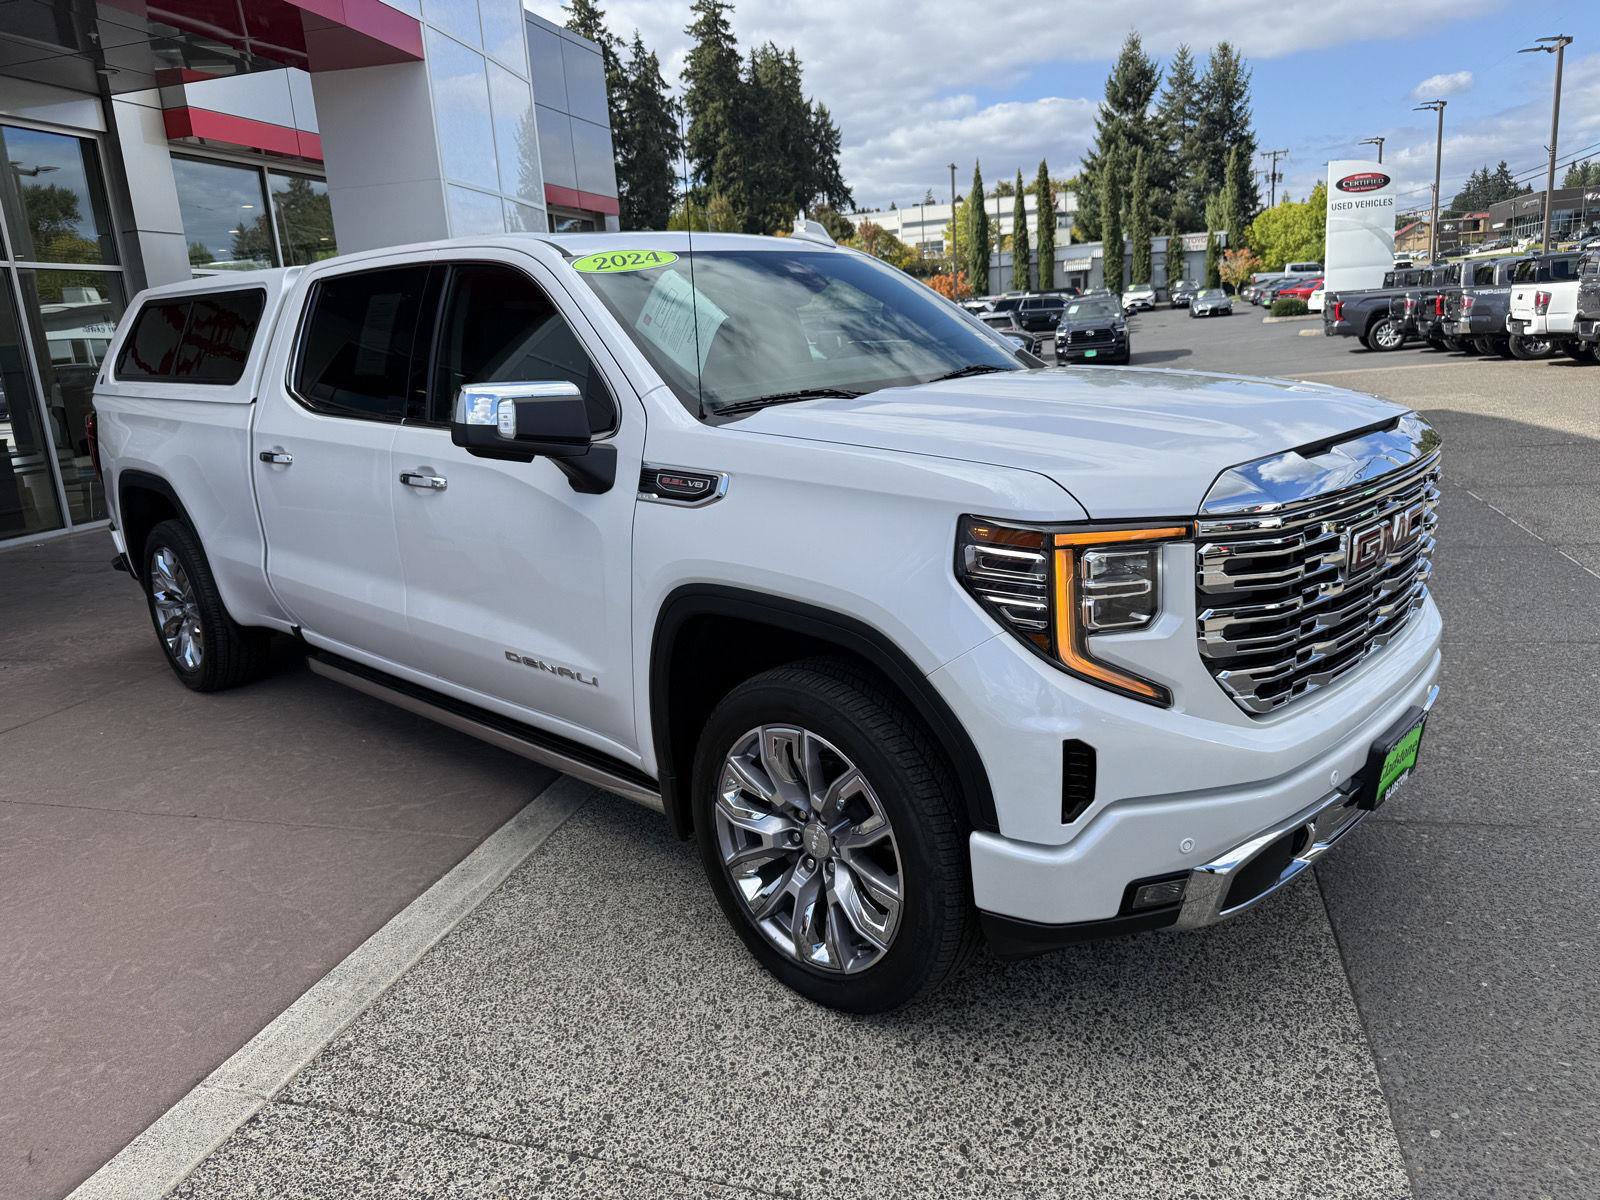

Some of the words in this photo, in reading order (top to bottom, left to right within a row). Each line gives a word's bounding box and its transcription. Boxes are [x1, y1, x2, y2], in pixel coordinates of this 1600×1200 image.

[1342, 178, 1385, 188] CERTIFIED
[1331, 201, 1353, 211] USED
[1355, 198, 1393, 209] VEHICLES
[592, 251, 663, 271] 2024
[687, 480, 704, 489] V8
[1350, 502, 1424, 573] GMC
[504, 650, 600, 688] DENALI
